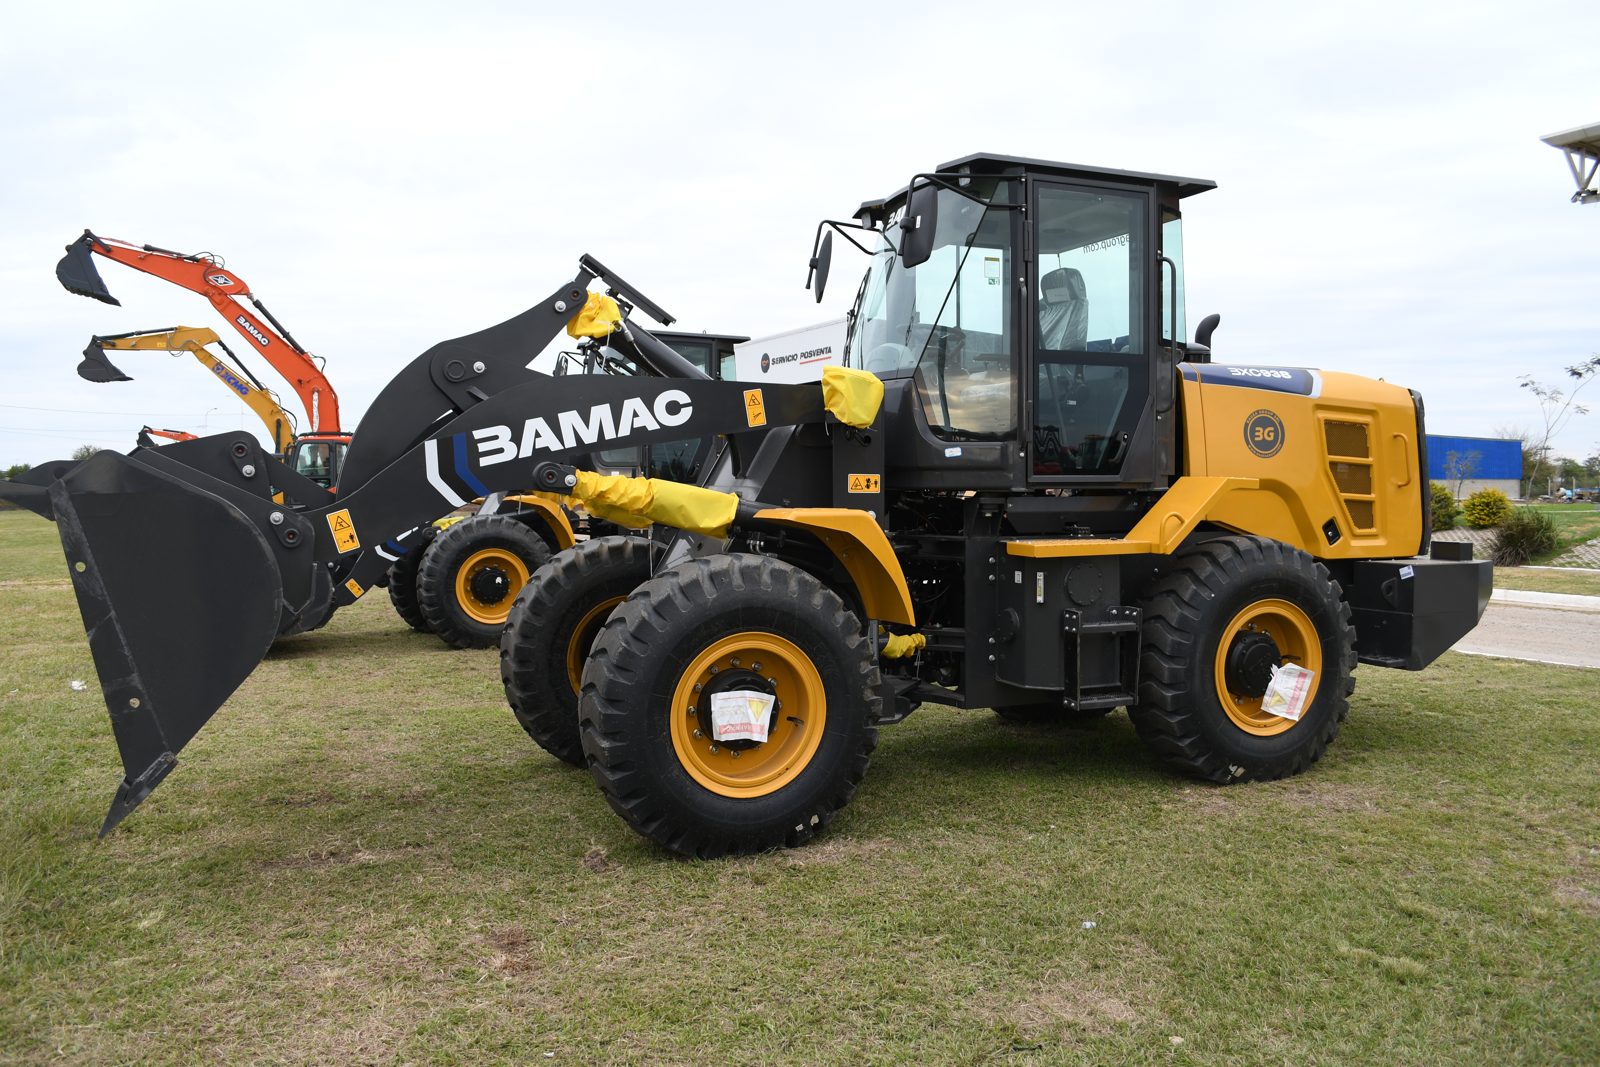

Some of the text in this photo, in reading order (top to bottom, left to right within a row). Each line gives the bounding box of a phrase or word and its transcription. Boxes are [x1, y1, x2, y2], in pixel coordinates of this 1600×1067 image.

[771, 353, 798, 366] SERVICIO
[800, 346, 832, 360] POSVENTA
[221, 371, 250, 395] XCMG
[472, 389, 693, 467] BAMAC
